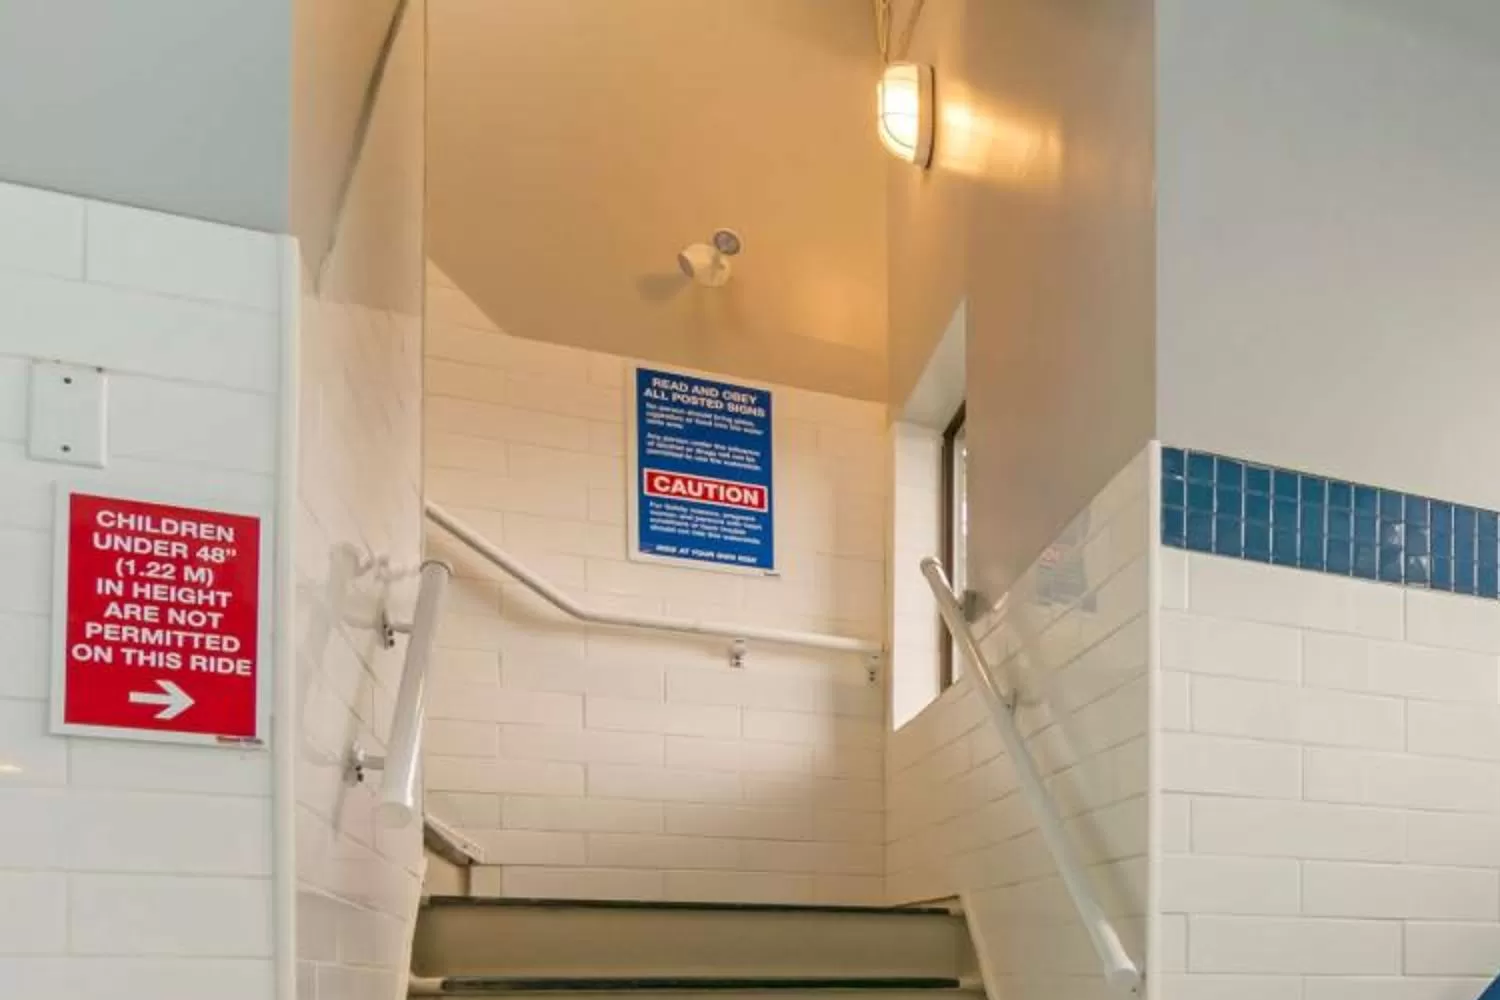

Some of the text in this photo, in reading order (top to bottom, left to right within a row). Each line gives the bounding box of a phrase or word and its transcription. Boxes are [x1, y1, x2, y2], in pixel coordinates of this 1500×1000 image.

[644, 389, 668, 401] ALL
[671, 392, 724, 410] POSTED
[727, 401, 766, 417] SIGNS
[652, 377, 757, 404] READ AND OBEY
[653, 475, 759, 506] CAUTION
[96, 510, 235, 543] CHILDREN
[93, 532, 188, 560] UNDER
[115, 557, 214, 588] (1.22 M)
[96, 578, 232, 608] IN HEIGHT
[104, 601, 223, 629] ARE NOT
[85, 621, 241, 653] PERMITTED
[71, 643, 253, 676] ON THIS RIDE
